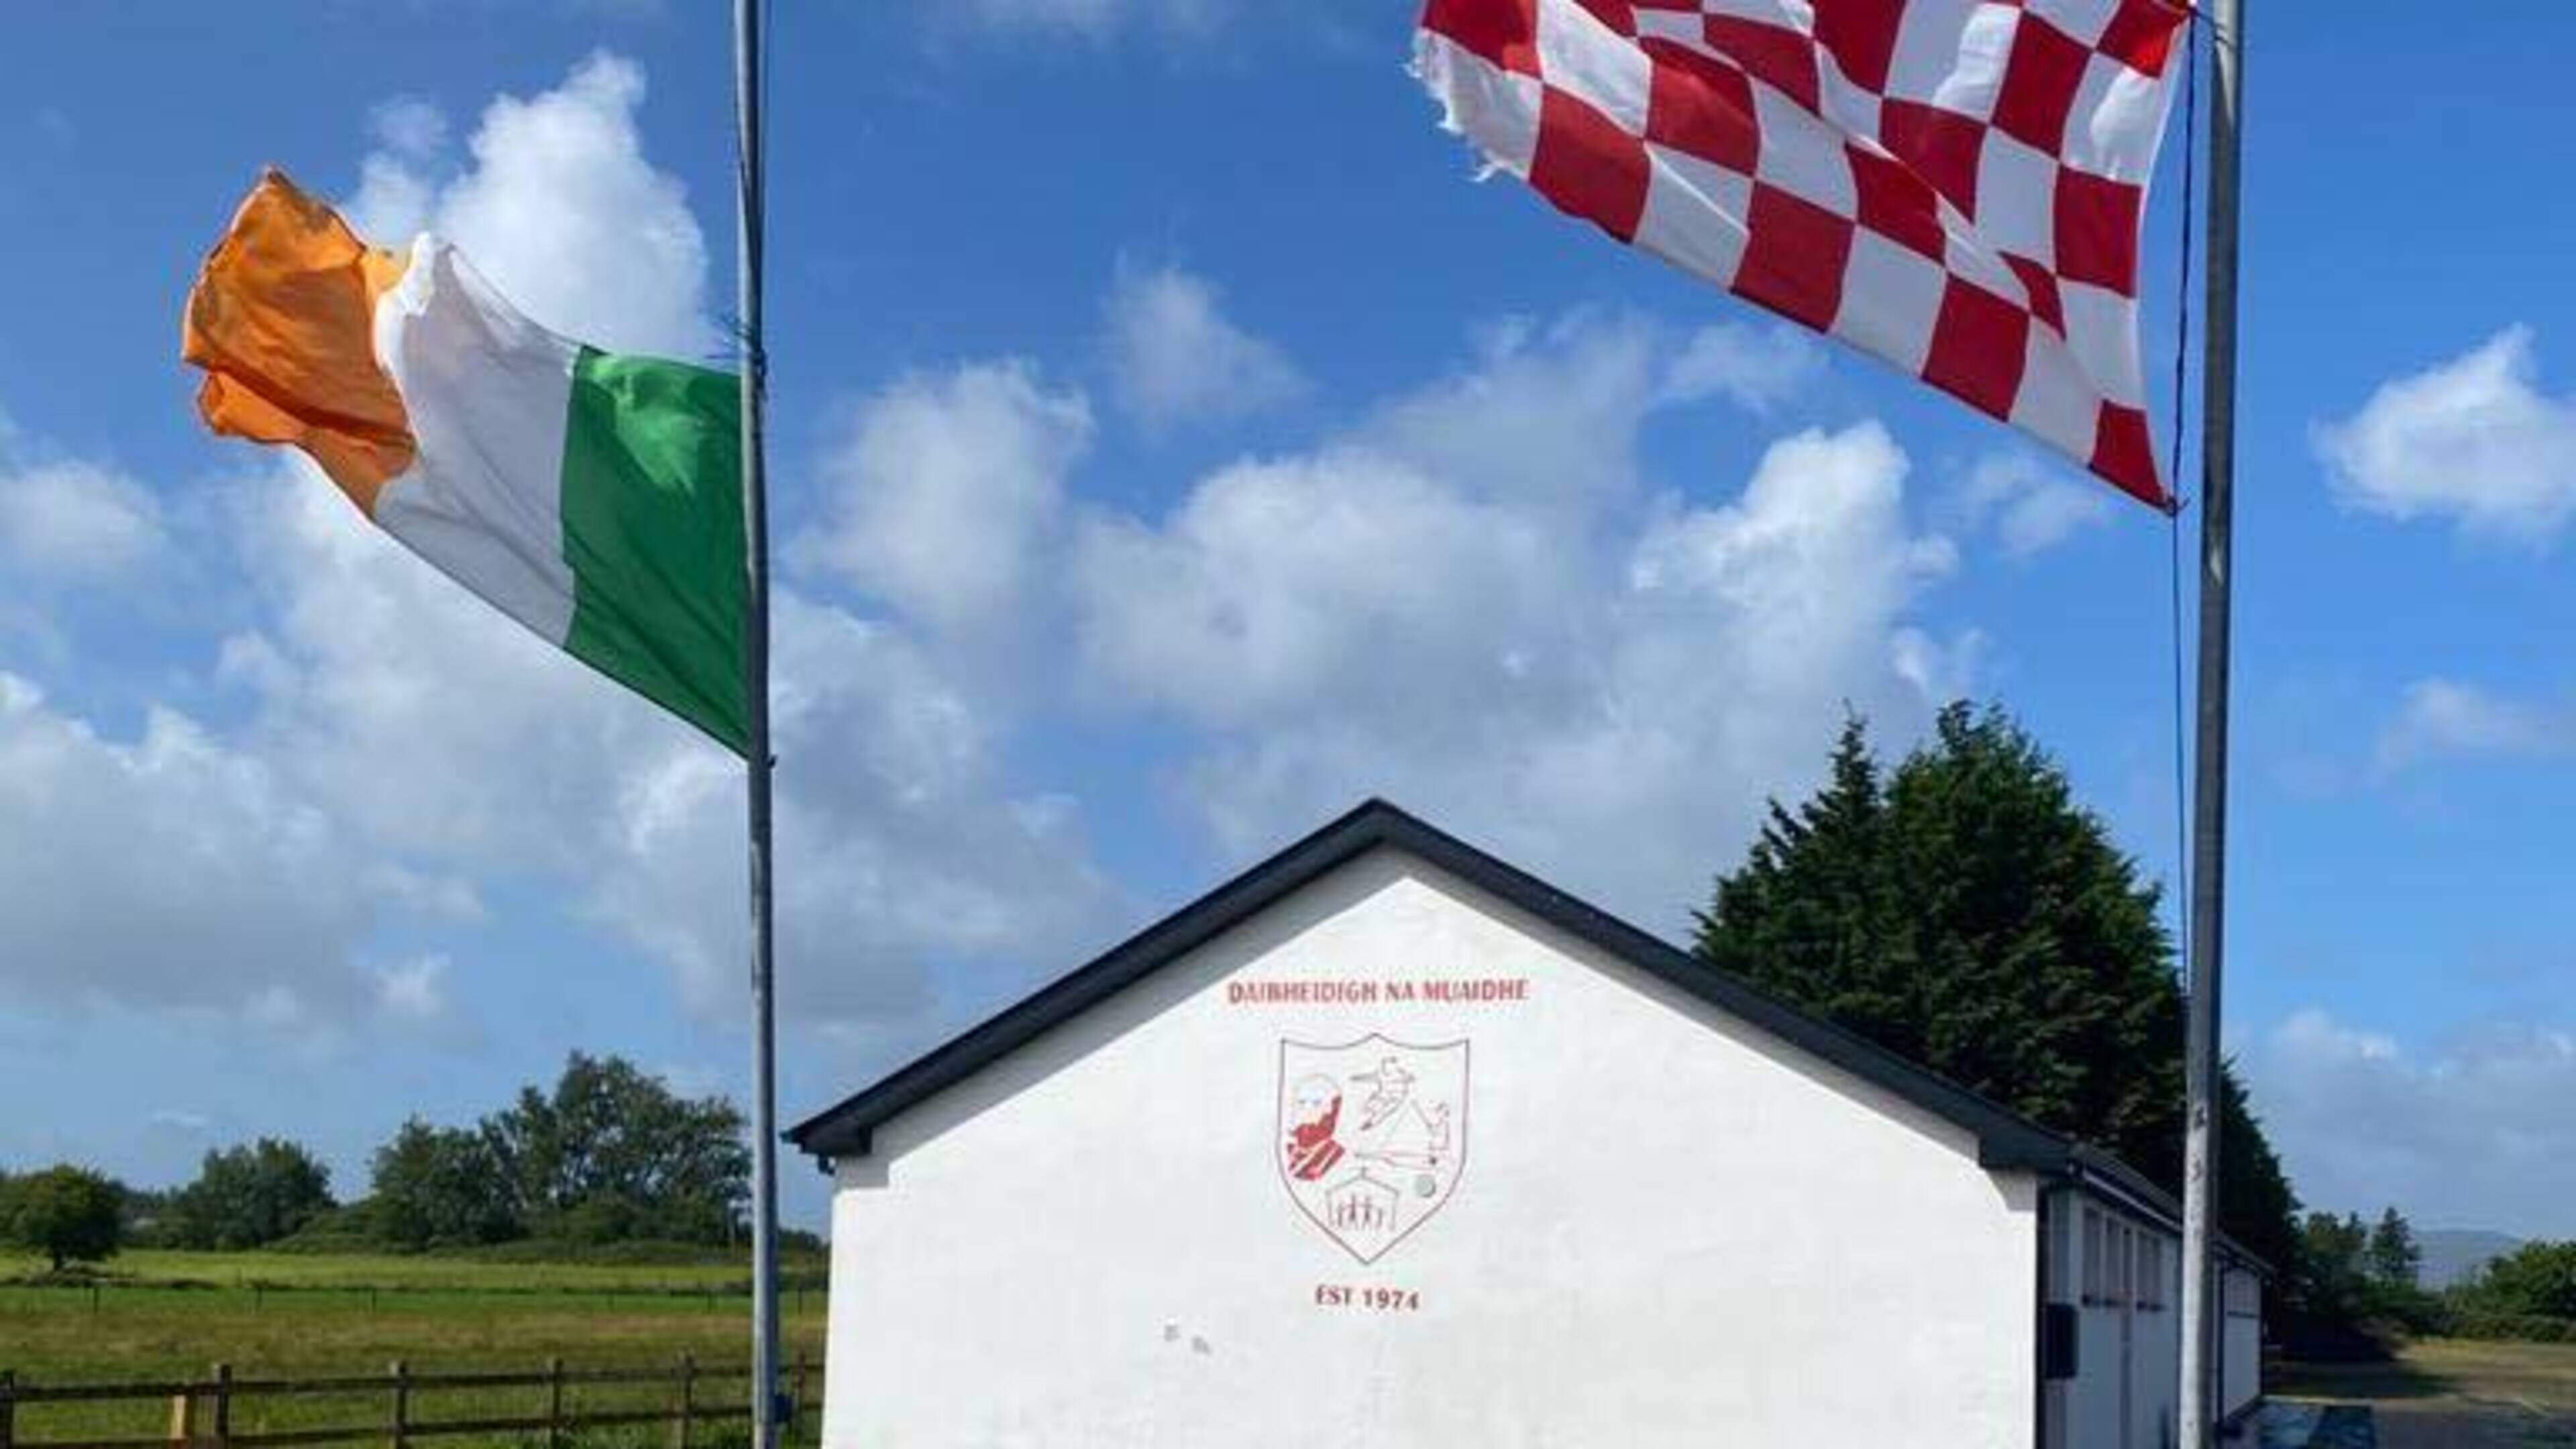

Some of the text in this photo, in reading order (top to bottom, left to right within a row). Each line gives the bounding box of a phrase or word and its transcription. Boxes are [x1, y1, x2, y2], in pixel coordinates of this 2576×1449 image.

[1385, 980, 1414, 1002] NA
[1316, 1284, 1419, 1311] EST 1974
